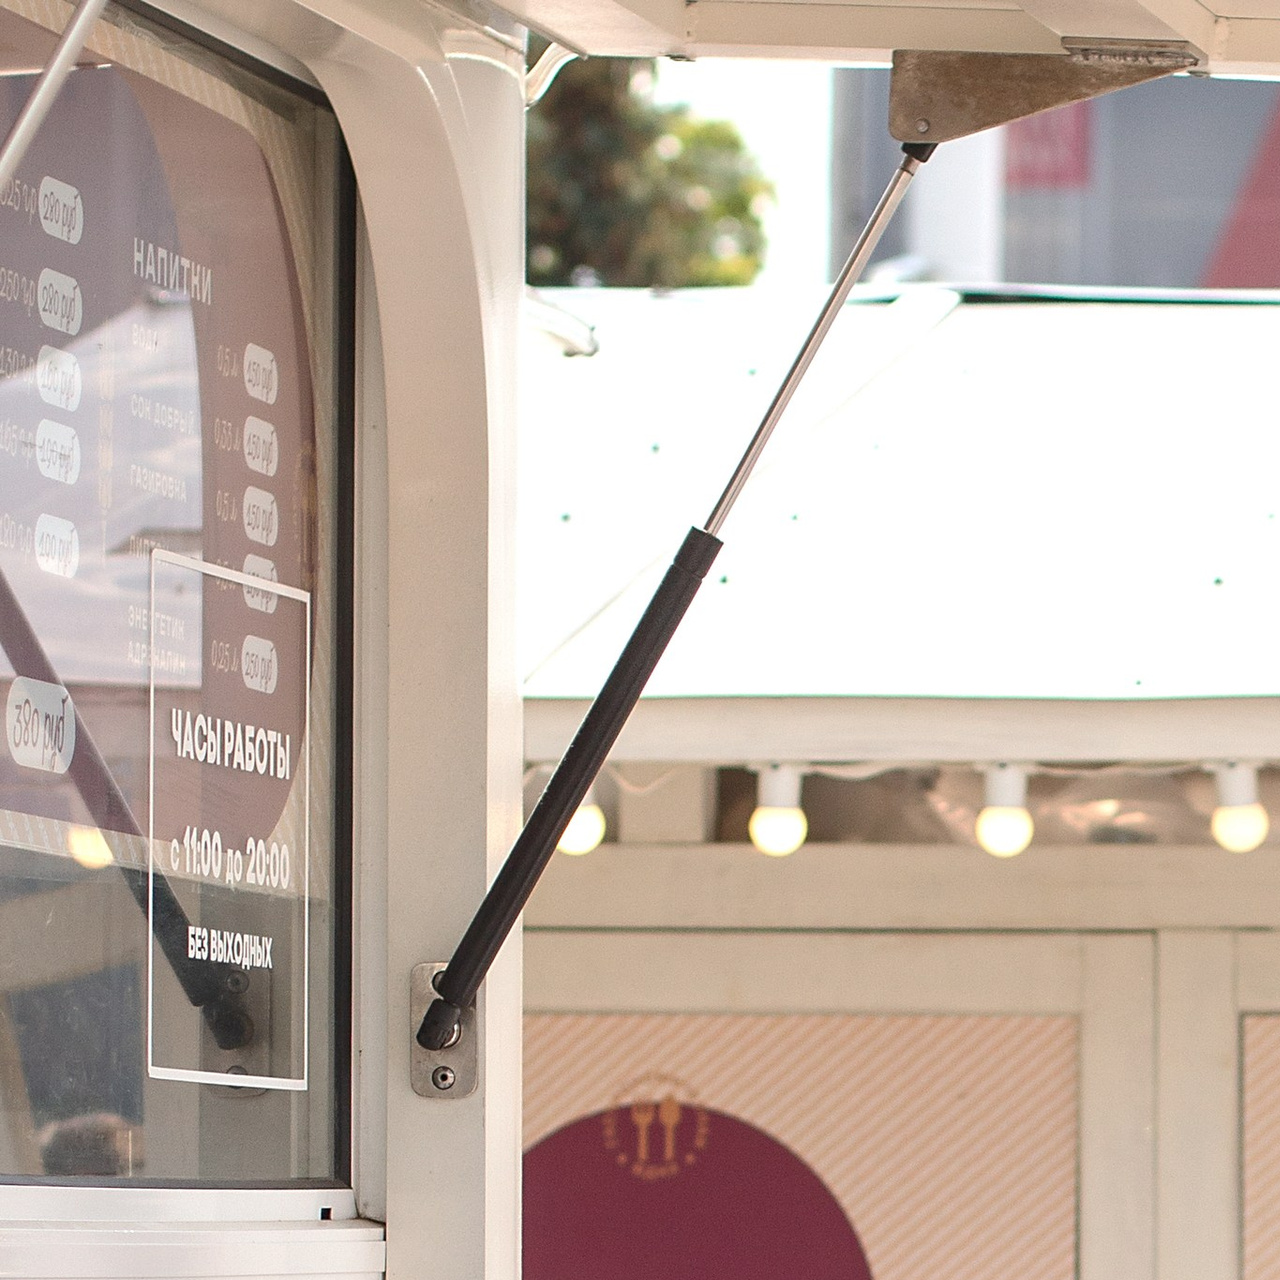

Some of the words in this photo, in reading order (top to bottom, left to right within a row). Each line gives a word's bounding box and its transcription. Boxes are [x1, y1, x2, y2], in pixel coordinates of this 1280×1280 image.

[43, 191, 60, 224] 280
[133, 237, 211, 305] НАПИТКИ
[42, 283, 59, 316] 280
[131, 394, 151, 420] СОК
[128, 604, 185, 640] ЭНЕГЕТИК
[127, 640, 186, 676] АДРНАЛИН
[14, 698, 39, 748] 380
[41, 695, 69, 771] руб
[172, 708, 221, 766] ЧАСЫ
[224, 720, 290, 780] РАБОТЫ
[183, 825, 222, 878] 11:00
[246, 837, 290, 889] 20:00
[188, 926, 208, 960] БЕЗ
[210, 929, 273, 970] ВЫХОДНЫХ
